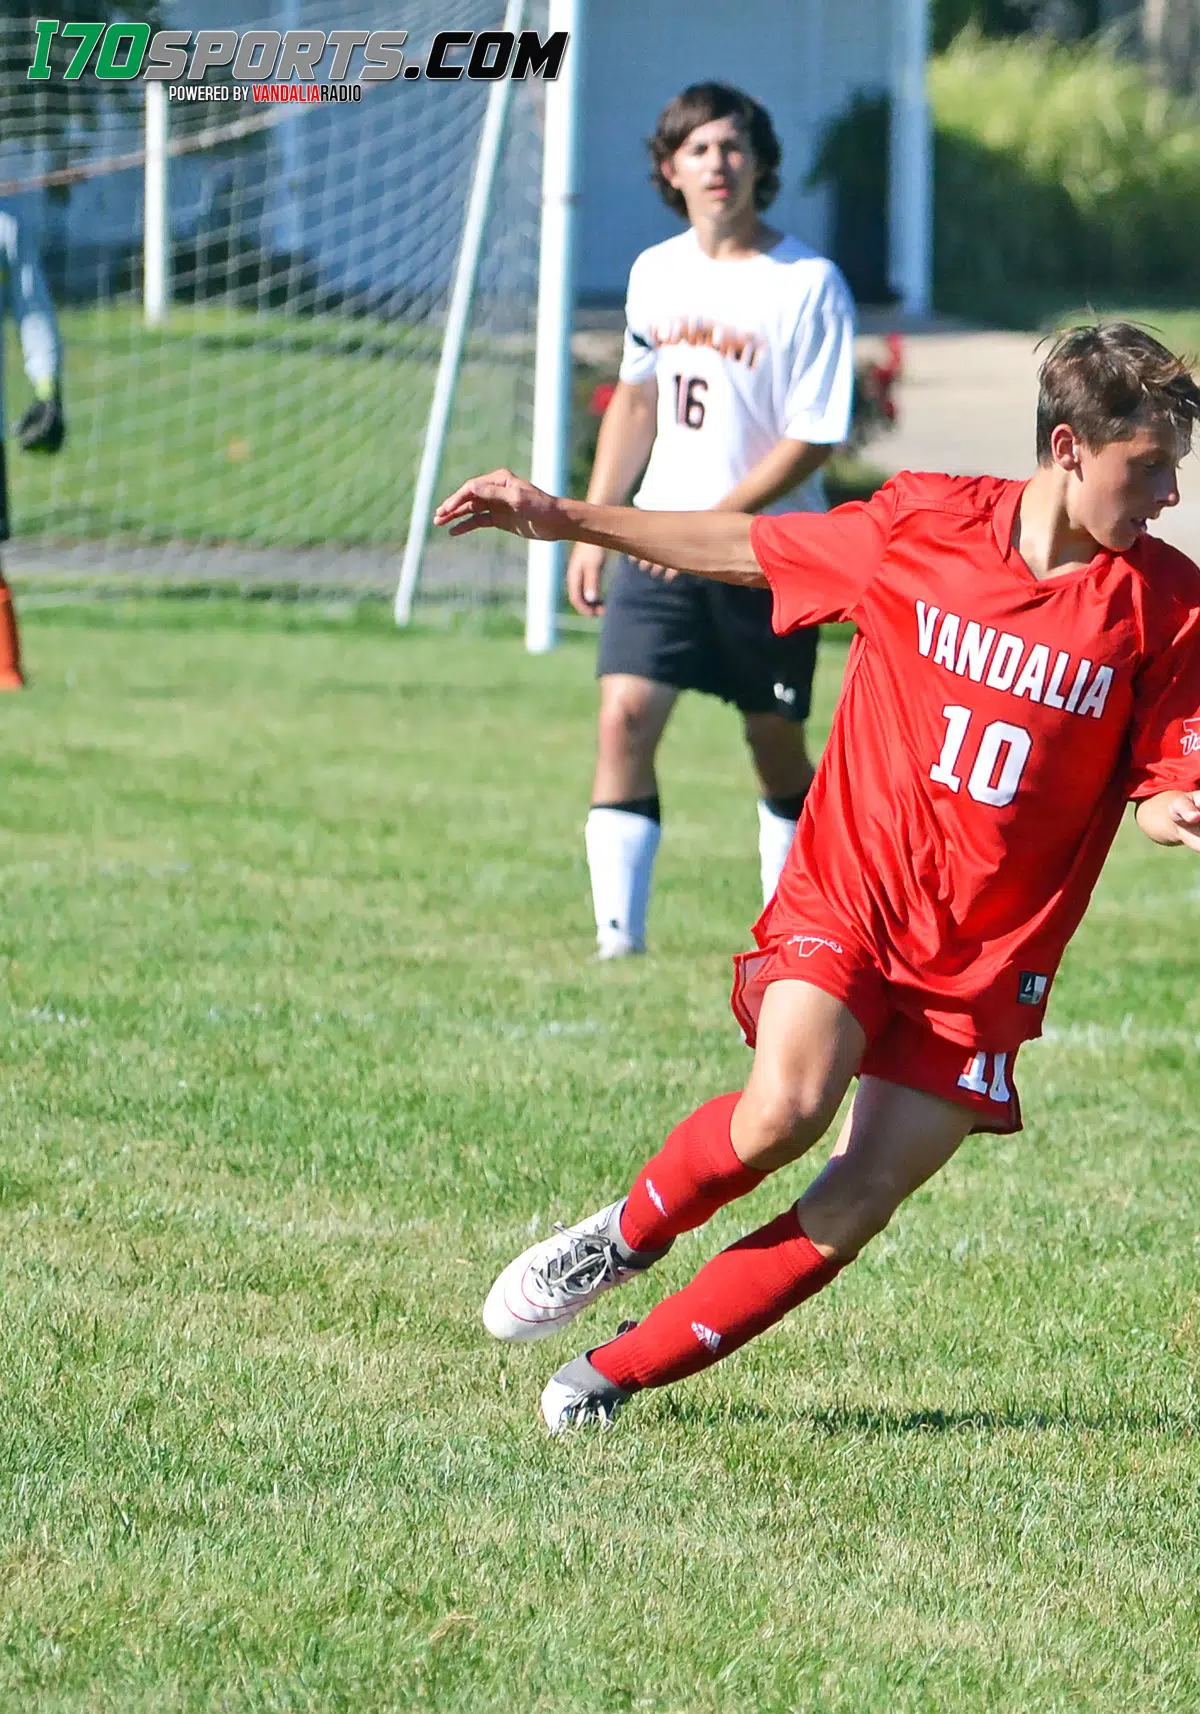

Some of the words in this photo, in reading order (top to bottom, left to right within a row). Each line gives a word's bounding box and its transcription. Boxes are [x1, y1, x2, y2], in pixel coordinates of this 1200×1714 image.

[672, 374, 709, 431] 16
[914, 599, 1115, 719] VANDALIA
[929, 703, 1034, 808] 10
